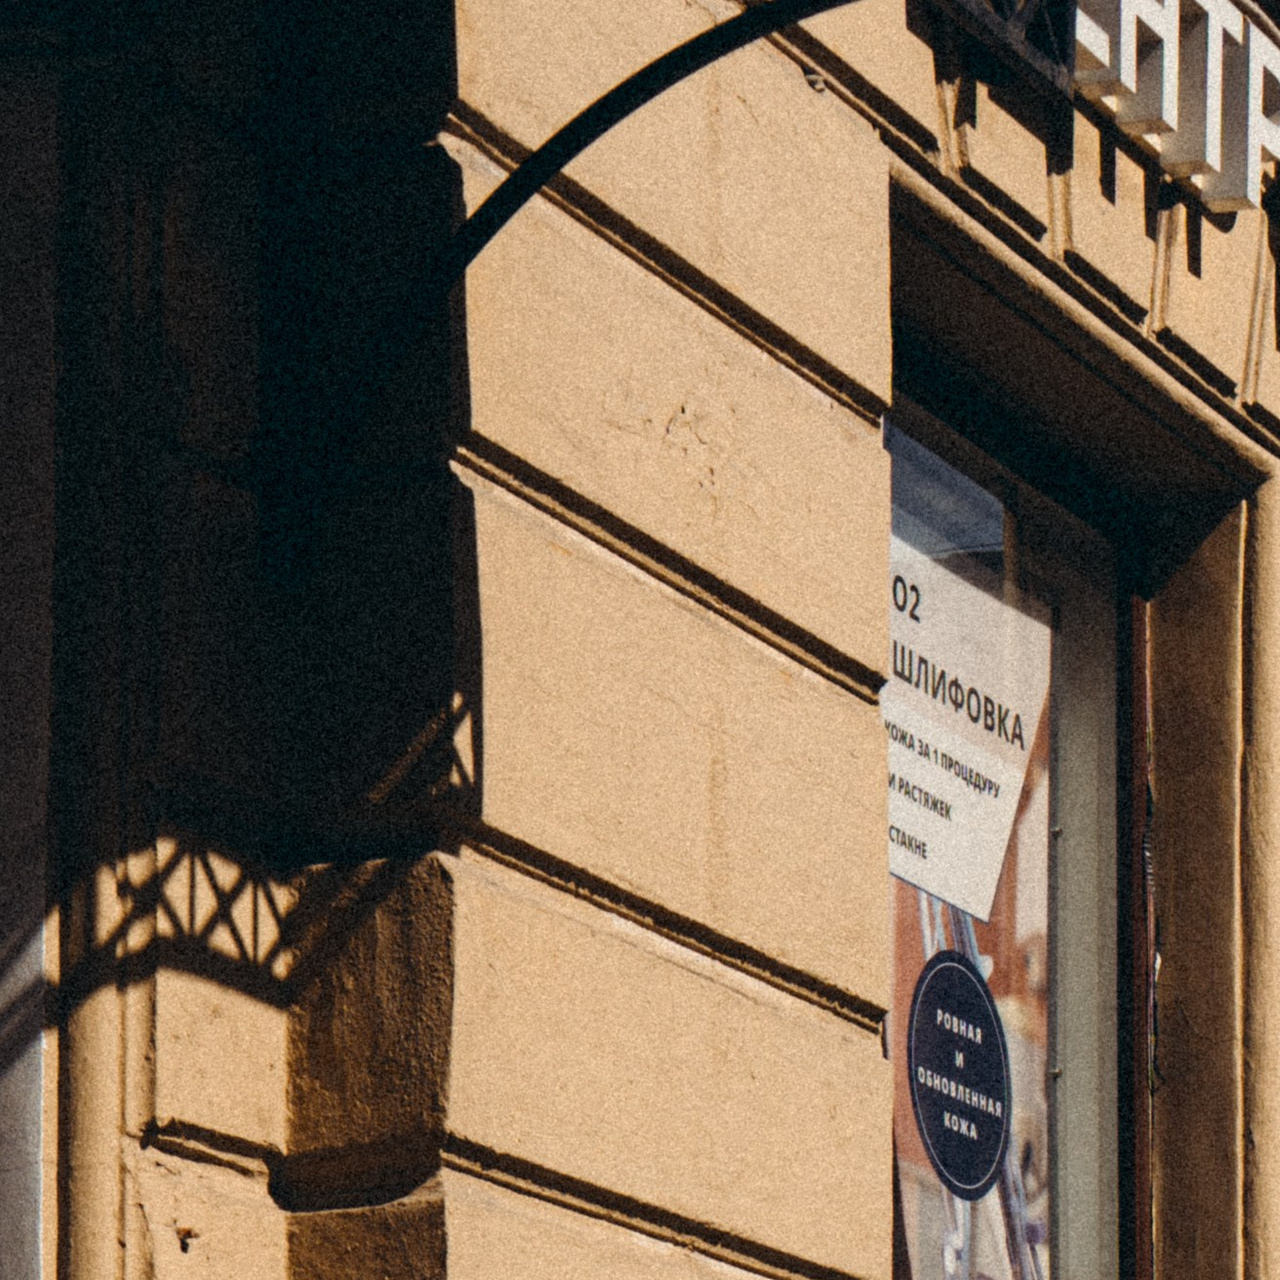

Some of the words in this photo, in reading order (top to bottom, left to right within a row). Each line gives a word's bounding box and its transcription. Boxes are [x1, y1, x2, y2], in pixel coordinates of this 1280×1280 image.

[892, 639, 1026, 751] ШЛИФОВКА
[917, 738, 931, 762] ЗА
[932, 747, 939, 766] 1
[940, 751, 1001, 799] ПРОЦЕДУРУ
[898, 776, 952, 822] РАСТЯЖЕК
[936, 1007, 983, 1045] РОВНАЯ
[954, 1050, 965, 1069] И
[917, 1065, 1003, 1119] ОБНОВЛЕННАЯ
[943, 1110, 979, 1141] КОЖА
